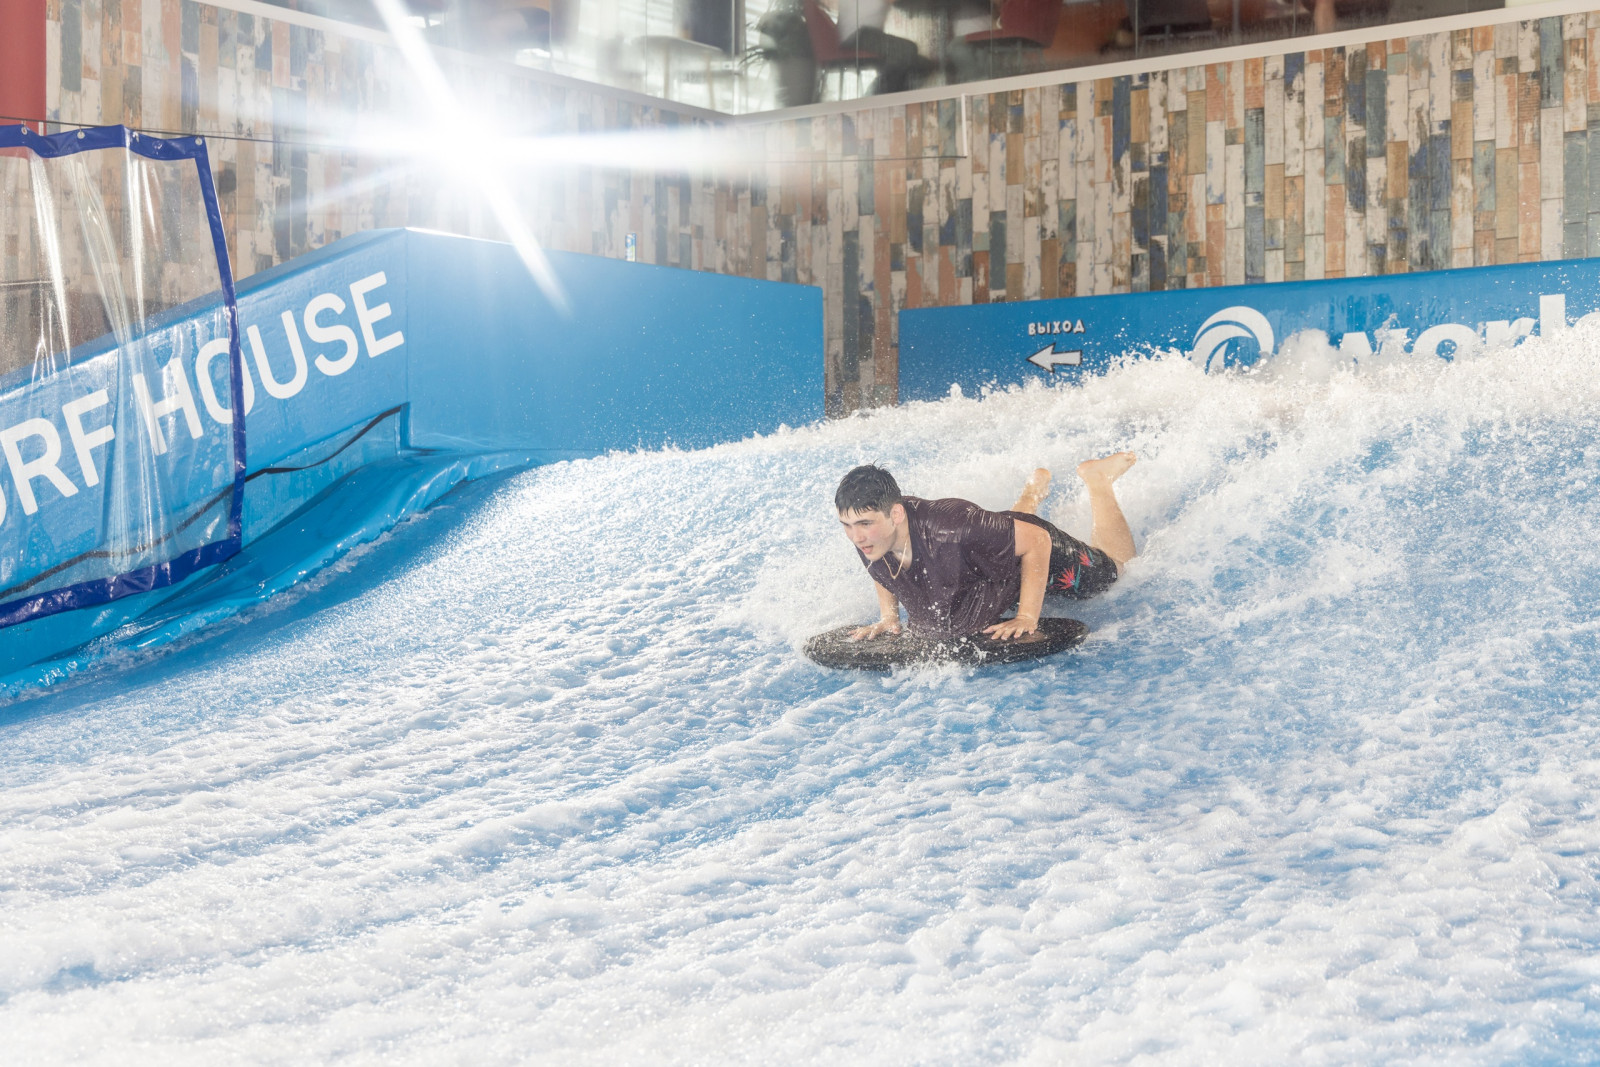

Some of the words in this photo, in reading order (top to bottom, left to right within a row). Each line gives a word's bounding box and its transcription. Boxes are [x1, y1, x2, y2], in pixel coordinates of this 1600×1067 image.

[1028, 319, 1085, 336] ВЫХОД
[1340, 294, 1600, 362] orl
[0, 389, 116, 526] RF
[132, 271, 405, 456] HOUSE
